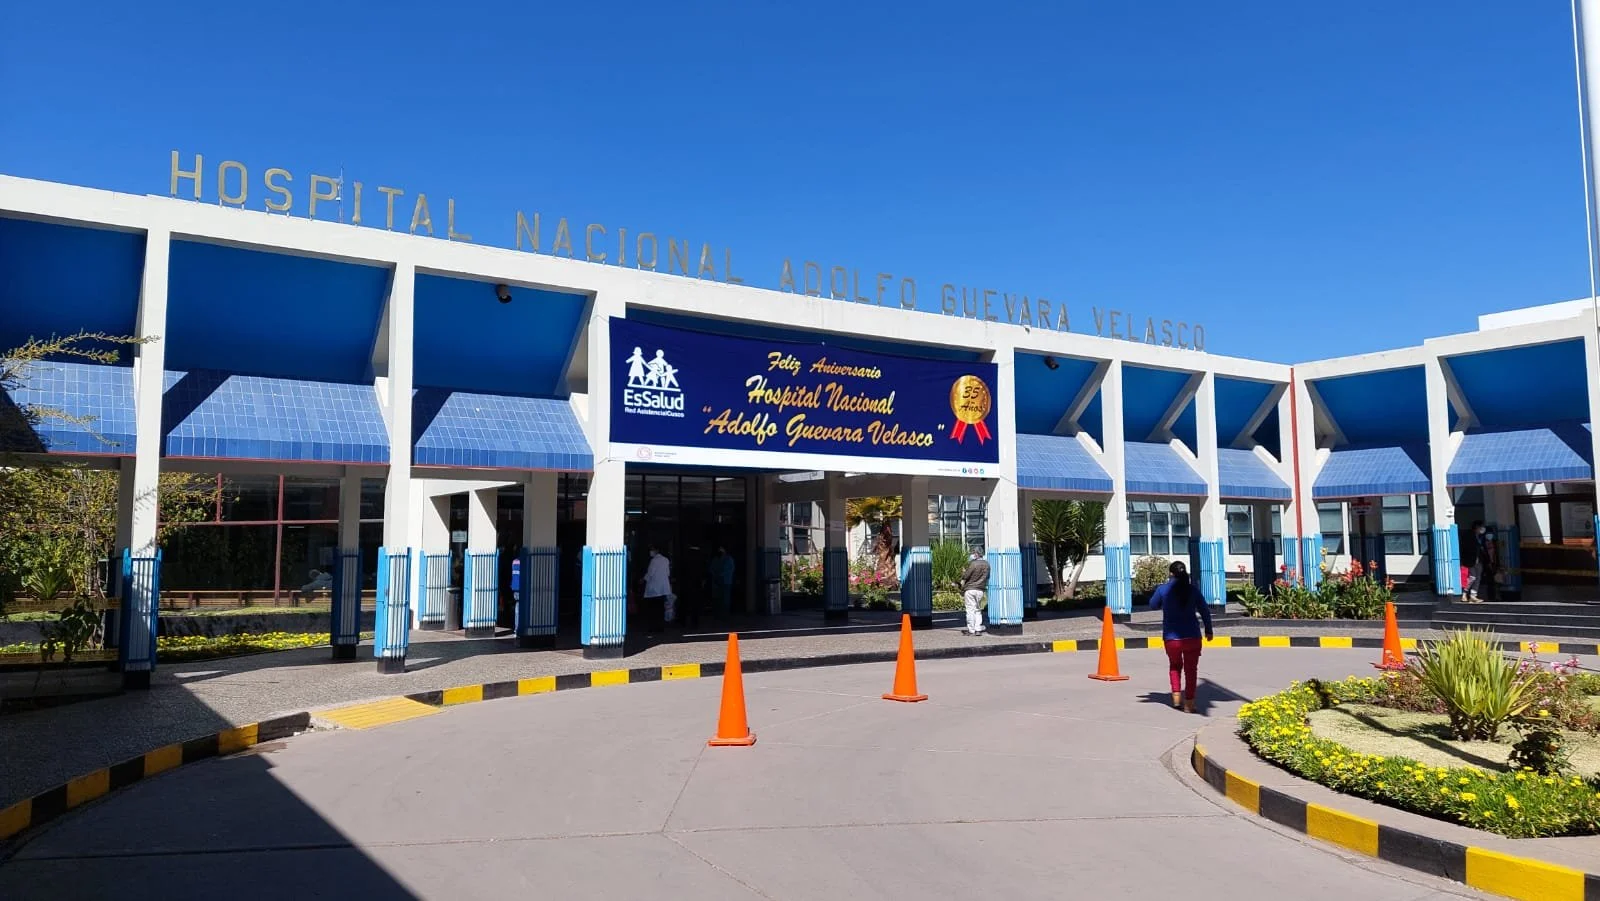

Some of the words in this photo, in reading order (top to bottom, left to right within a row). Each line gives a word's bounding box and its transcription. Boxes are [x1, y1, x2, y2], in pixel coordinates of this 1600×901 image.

[170, 150, 472, 240] HOSPITAL
[516, 210, 744, 283] NACIONAL
[779, 257, 917, 310] ADOLFO
[941, 283, 1070, 332] GUEVARA
[1092, 304, 1206, 351] VELASCO
[768, 351, 801, 376] Feliz
[809, 356, 882, 379] Aniversario
[624, 389, 684, 411] EsSalud
[745, 374, 822, 413] Hospital
[825, 381, 896, 415] Nacional
[960, 400, 983, 412] Años
[962, 385, 980, 399] 35
[786, 413, 864, 447] Guevara
